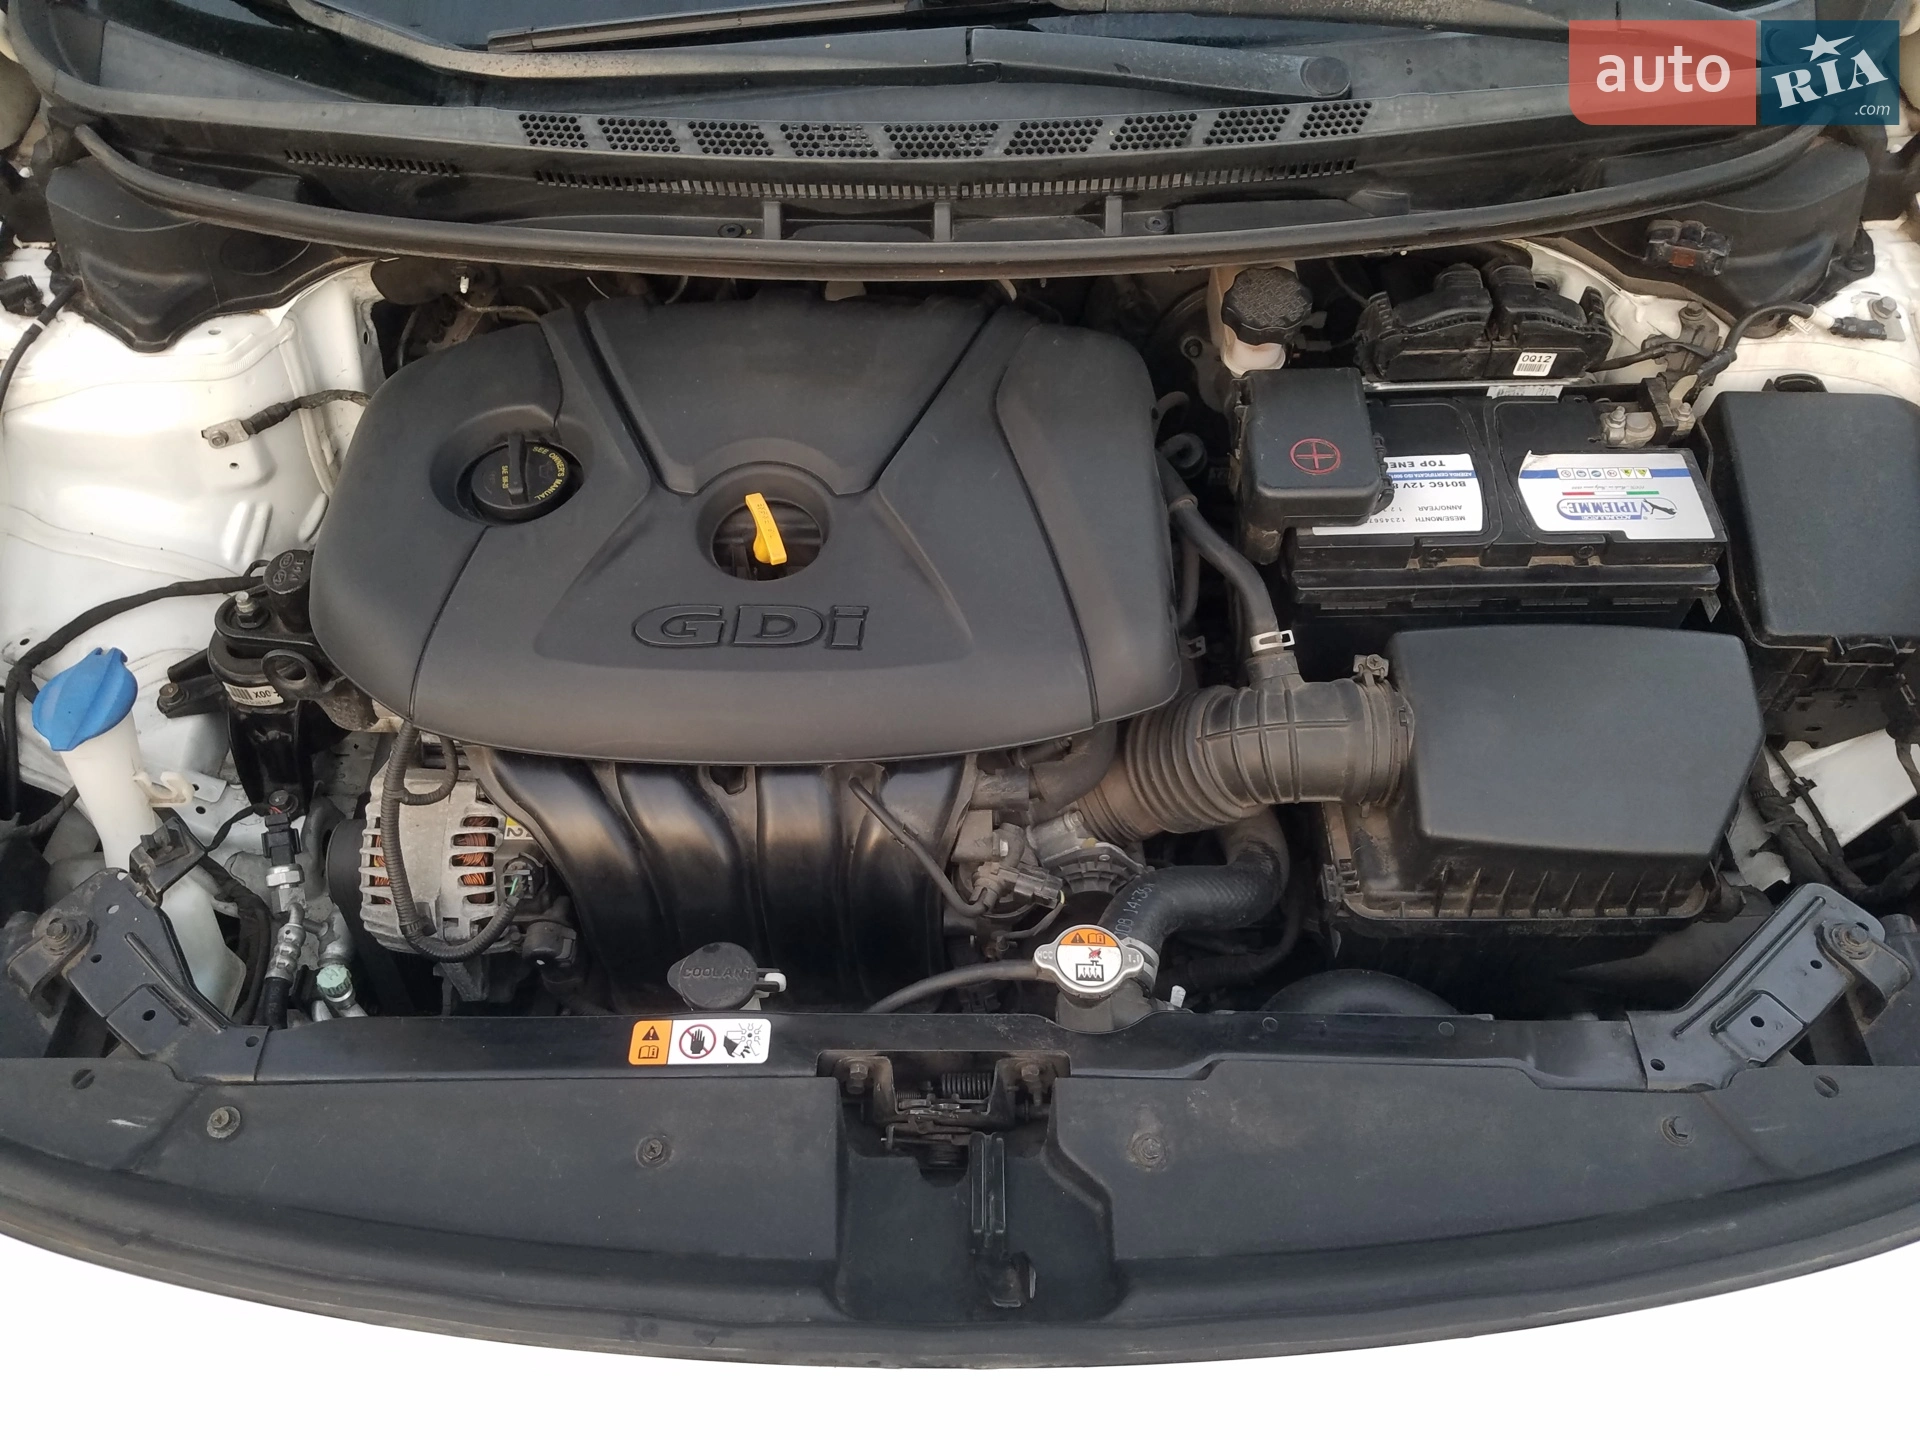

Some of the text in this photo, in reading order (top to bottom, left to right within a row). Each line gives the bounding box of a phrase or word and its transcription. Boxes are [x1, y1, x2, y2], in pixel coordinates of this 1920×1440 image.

[532, 446, 549, 455] SEE
[1387, 461, 1415, 469] ENE
[533, 478, 563, 501] MANUAL
[1567, 501, 1650, 514] VIPIEMME
[631, 603, 870, 651] GDi
[1036, 950, 1054, 960] HCC
[1127, 954, 1141, 963] 1.1
[683, 967, 754, 981] COOLANT
